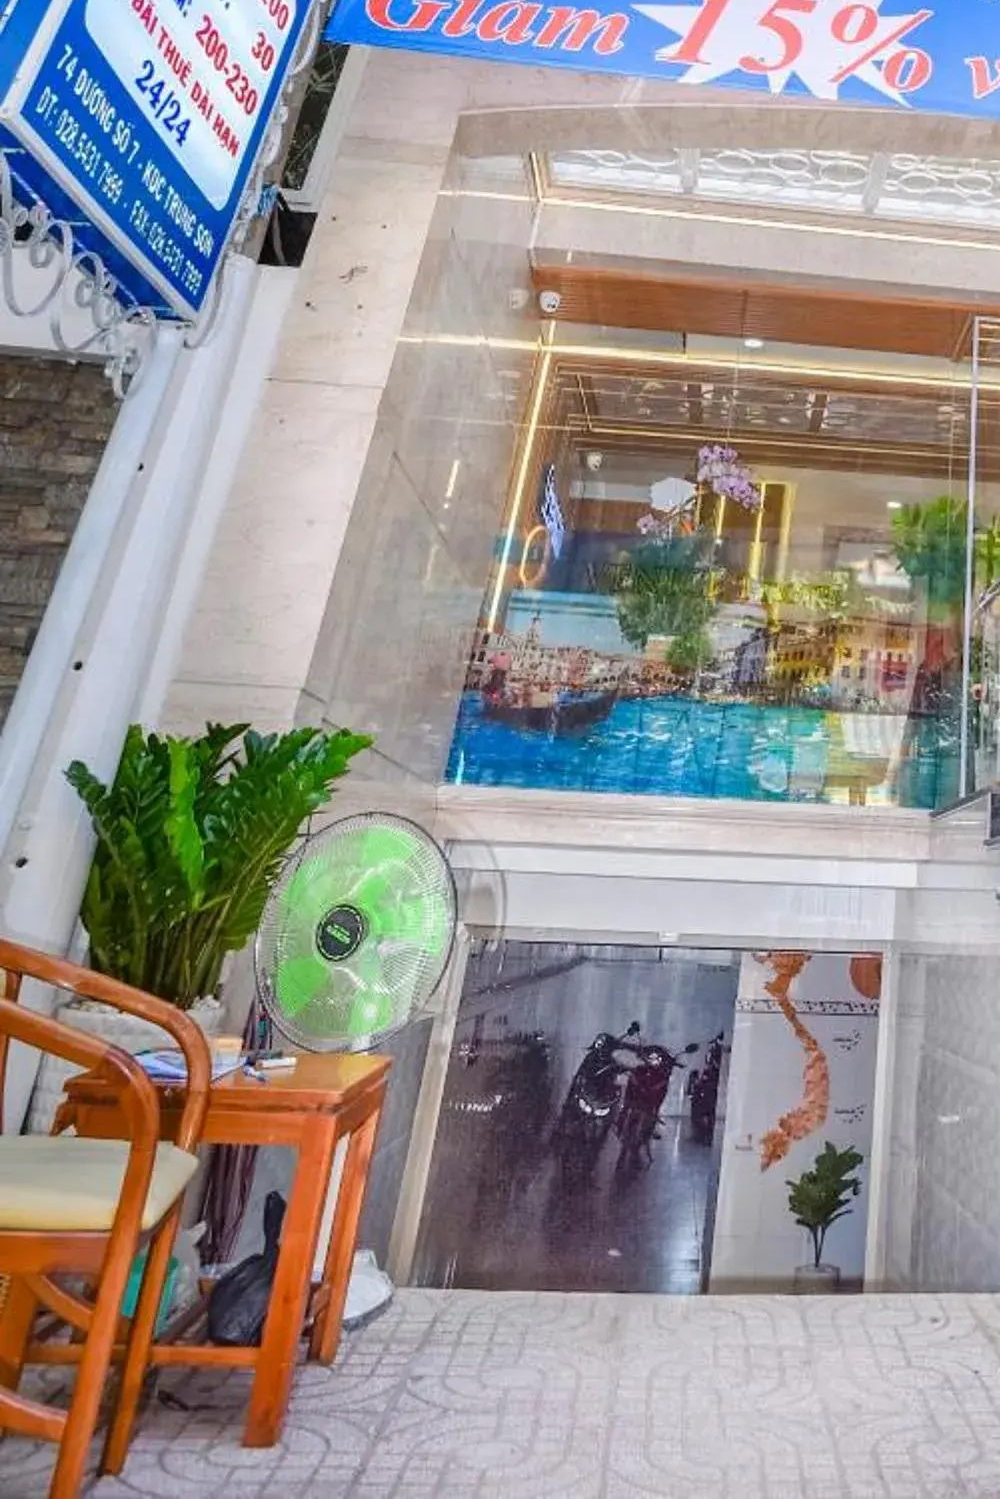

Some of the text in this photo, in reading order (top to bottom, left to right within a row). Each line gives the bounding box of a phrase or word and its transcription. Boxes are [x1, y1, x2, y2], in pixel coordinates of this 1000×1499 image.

[195, 14, 258, 116] 200-230
[251, 31, 276, 73] 30
[56, 43, 79, 82] 74
[127, 139, 140, 164] 7
[135, 59, 191, 147] 24/24
